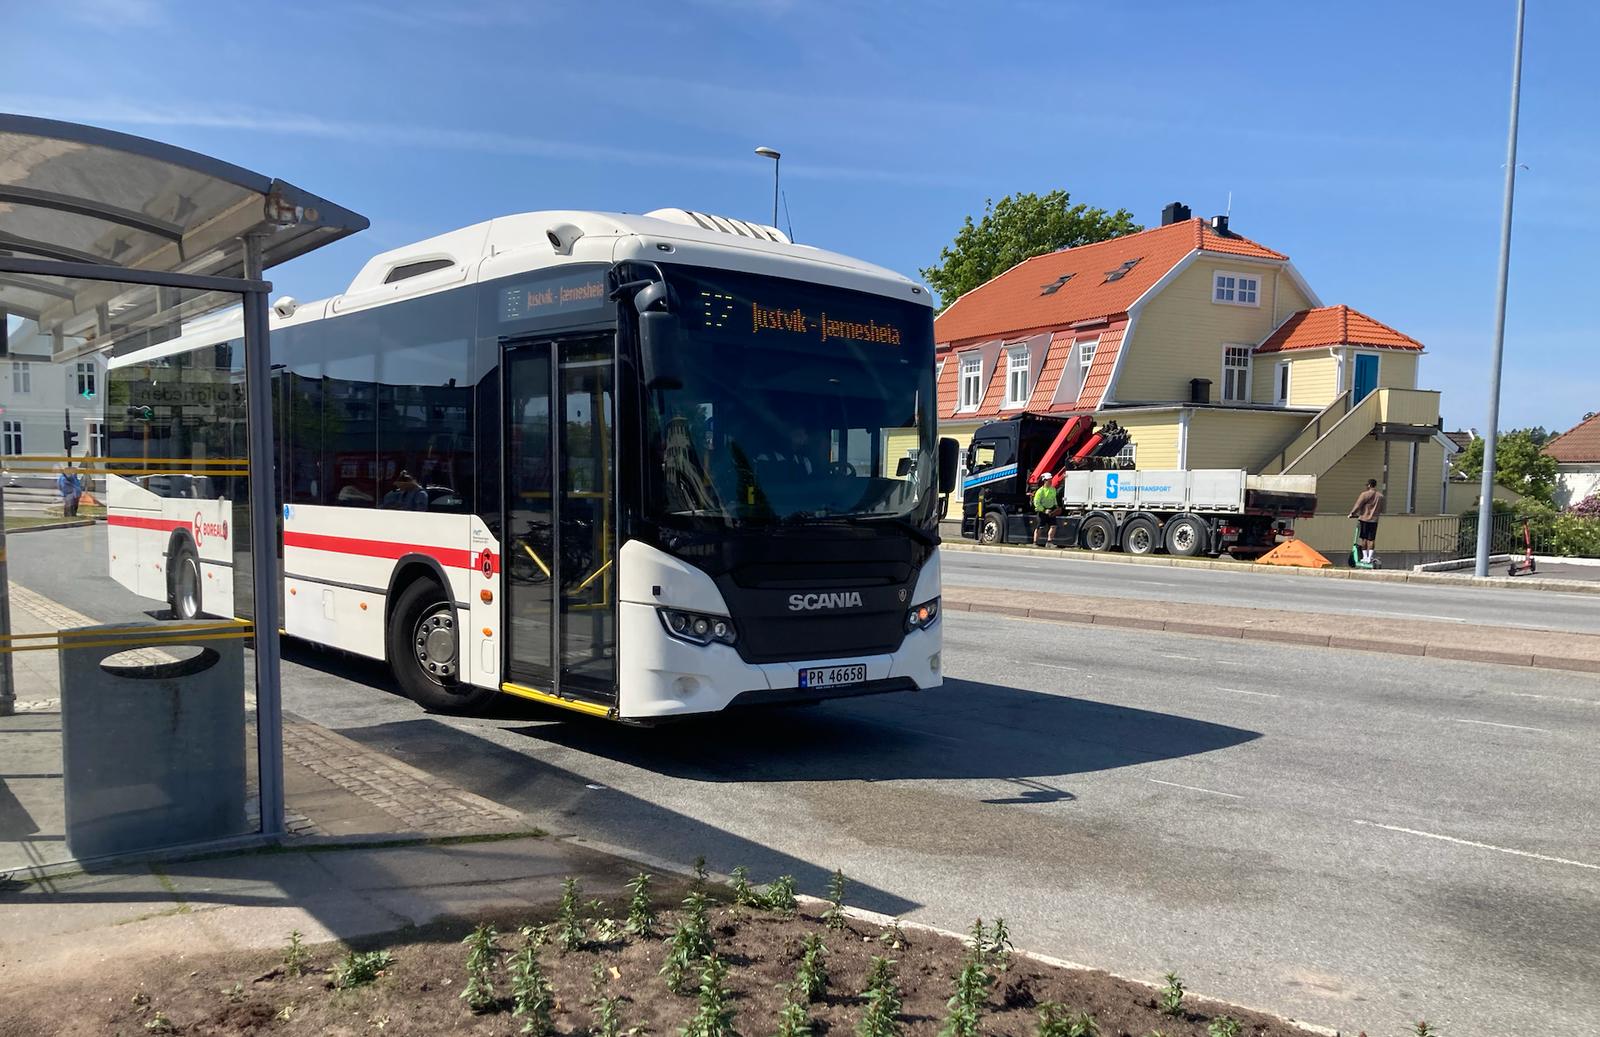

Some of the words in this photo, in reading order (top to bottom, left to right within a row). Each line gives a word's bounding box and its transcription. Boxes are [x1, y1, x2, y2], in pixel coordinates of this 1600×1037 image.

[752, 302, 807, 333] Justvik
[821, 312, 901, 345] Jærnesheia
[203, 522, 224, 537] BOREAL
[788, 592, 863, 611] SCANIA
[809, 671, 824, 685] PR
[829, 666, 863, 683] 46658
